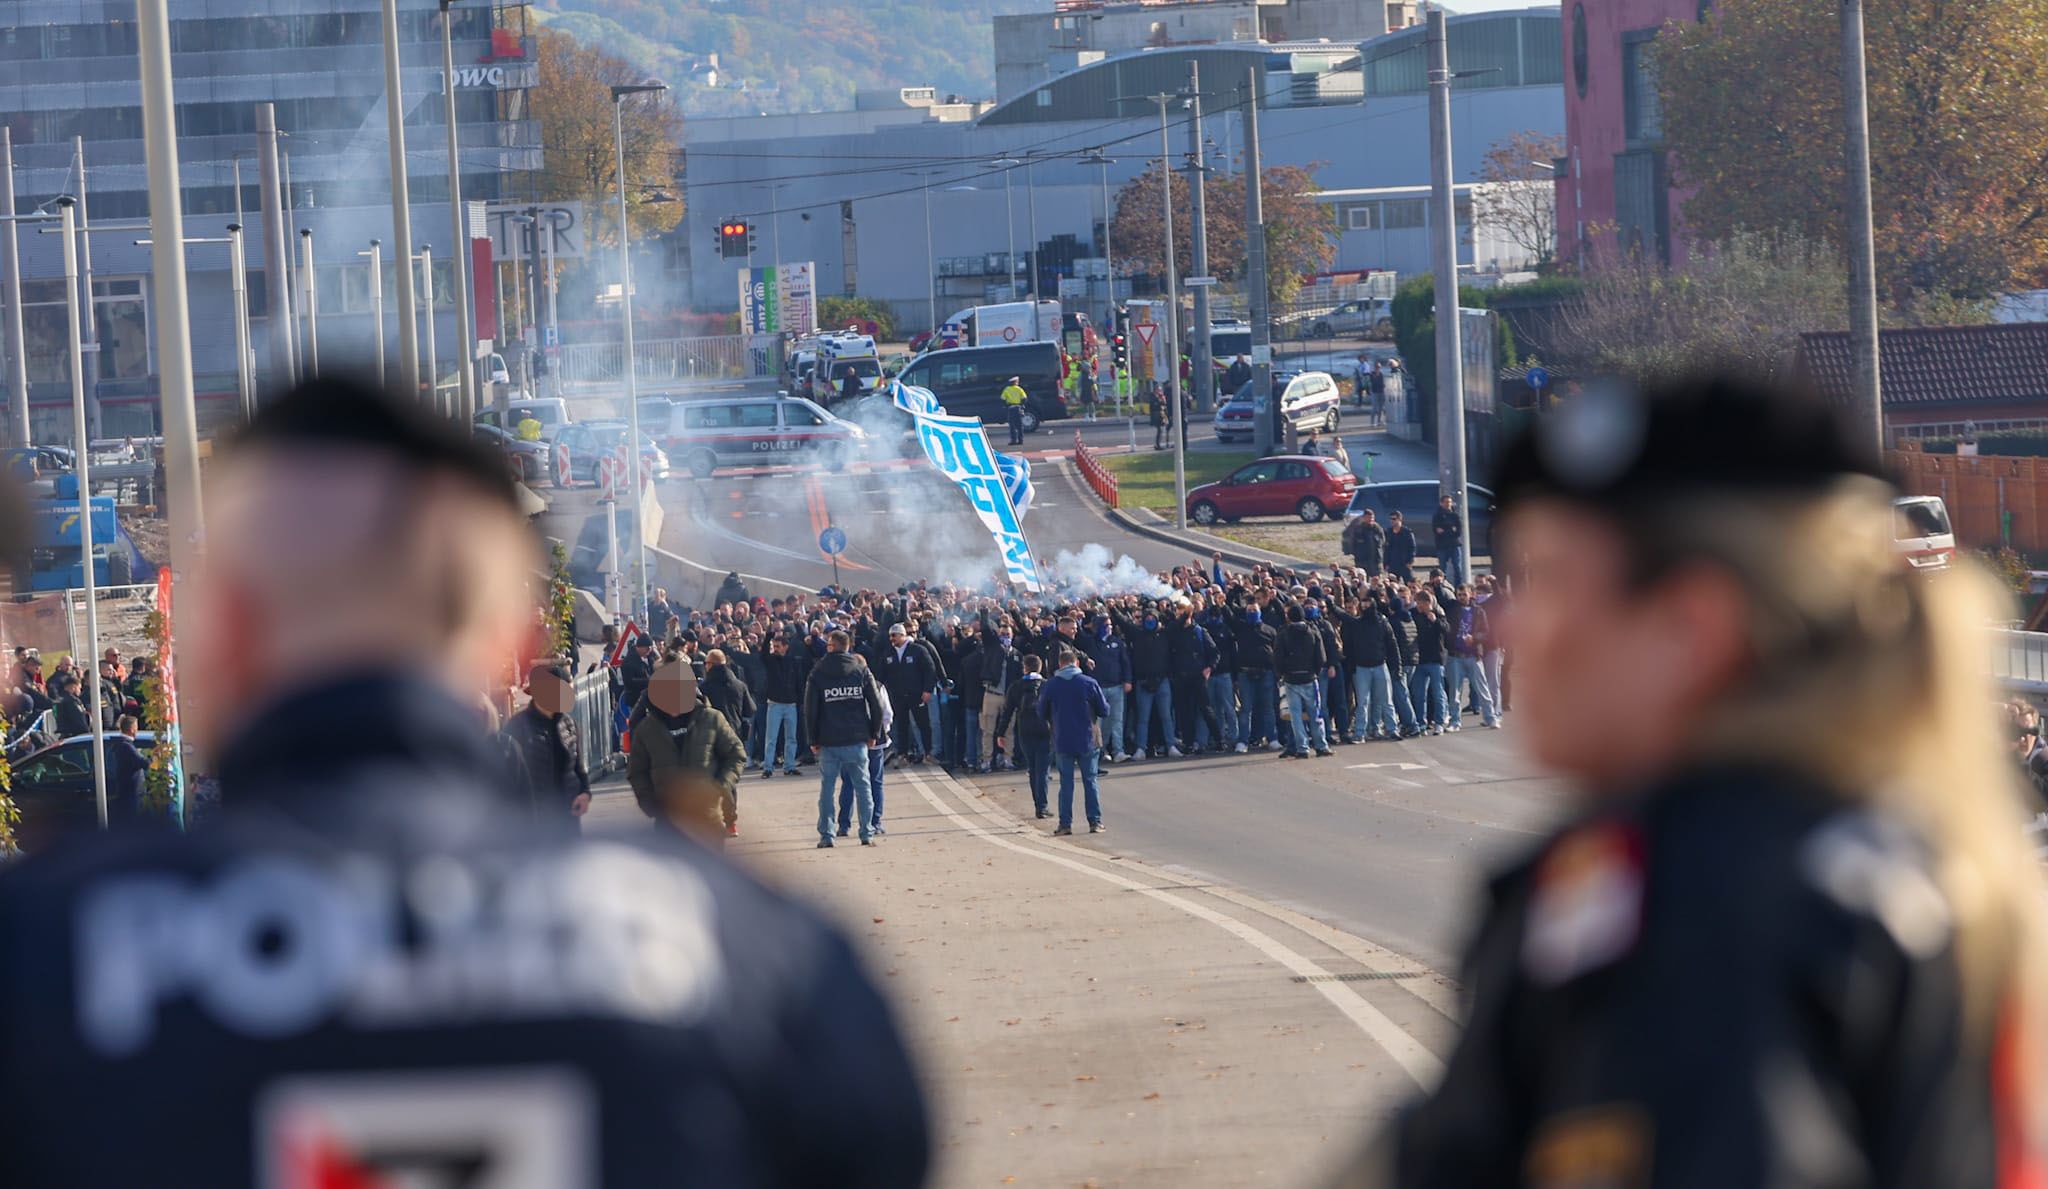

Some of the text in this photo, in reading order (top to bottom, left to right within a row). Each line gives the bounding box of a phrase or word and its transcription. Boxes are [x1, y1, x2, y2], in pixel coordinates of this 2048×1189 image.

[440, 67, 504, 95] pwc
[752, 440, 801, 451] POLIZEI
[824, 686, 863, 698] POLIZEI
[74, 842, 724, 1058] POLI
